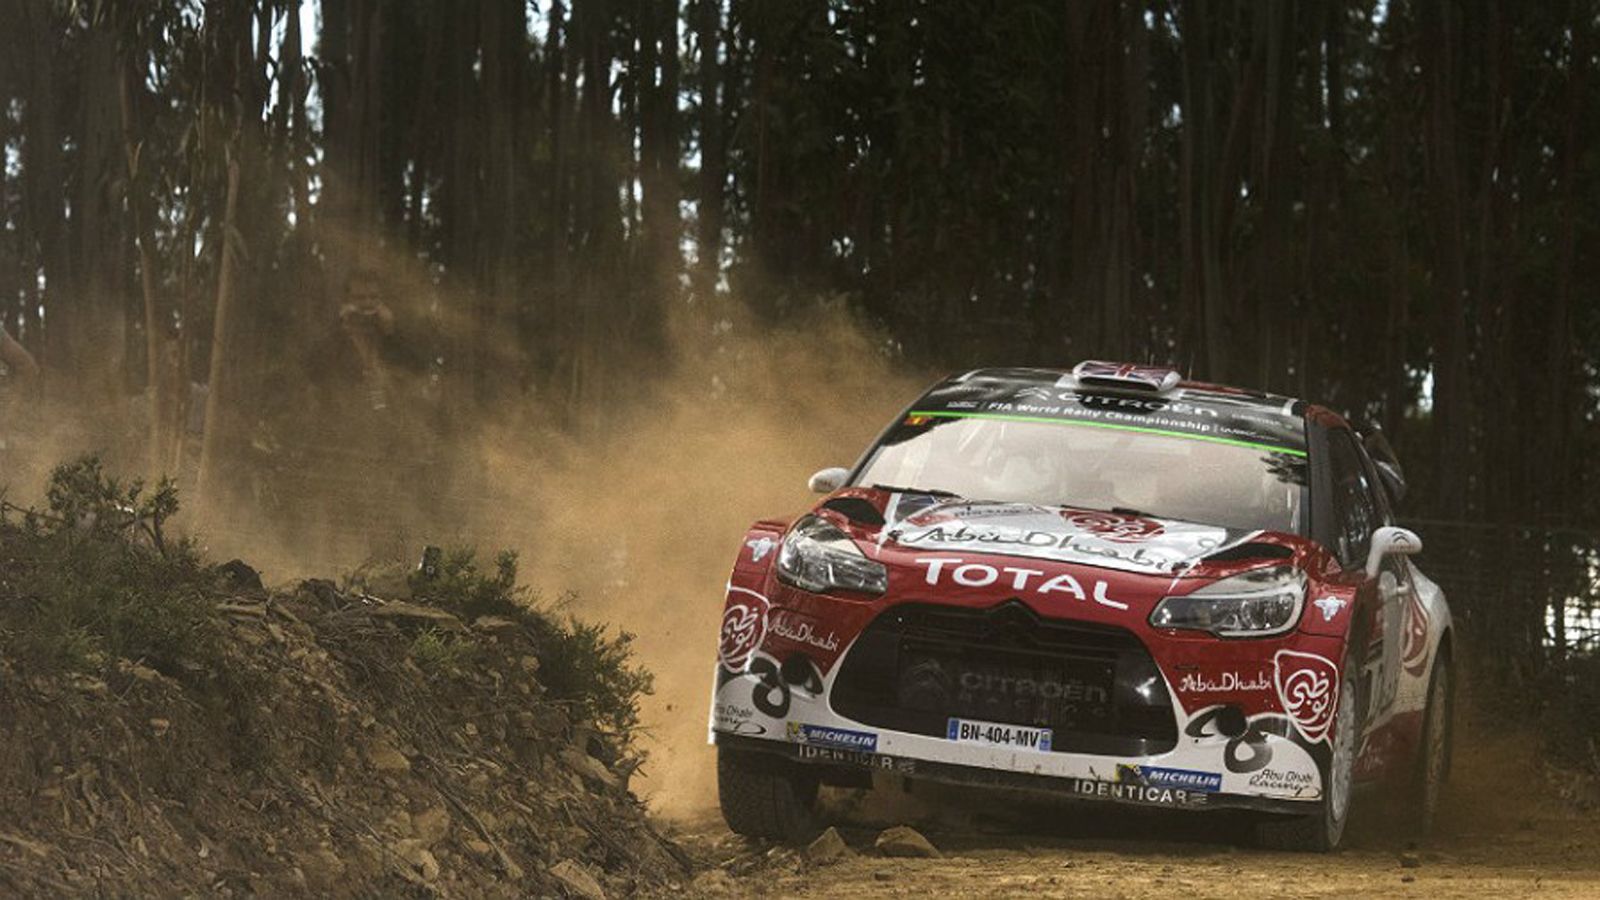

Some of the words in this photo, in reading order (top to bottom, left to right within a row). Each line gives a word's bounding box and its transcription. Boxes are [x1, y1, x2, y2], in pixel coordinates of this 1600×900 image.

[988, 402, 1013, 411] FIA
[1016, 404, 1060, 415] World
[1063, 407, 1102, 419] Rally
[1105, 411, 1211, 433] Championship
[915, 557, 1129, 611] TOTAL
[808, 729, 875, 747] MICHELIN
[960, 723, 1040, 748] BN-404-MV
[799, 744, 893, 770] IDENTICAR
[1149, 770, 1220, 787] MICHELIN
[1074, 779, 1187, 804] IDENTICAR
